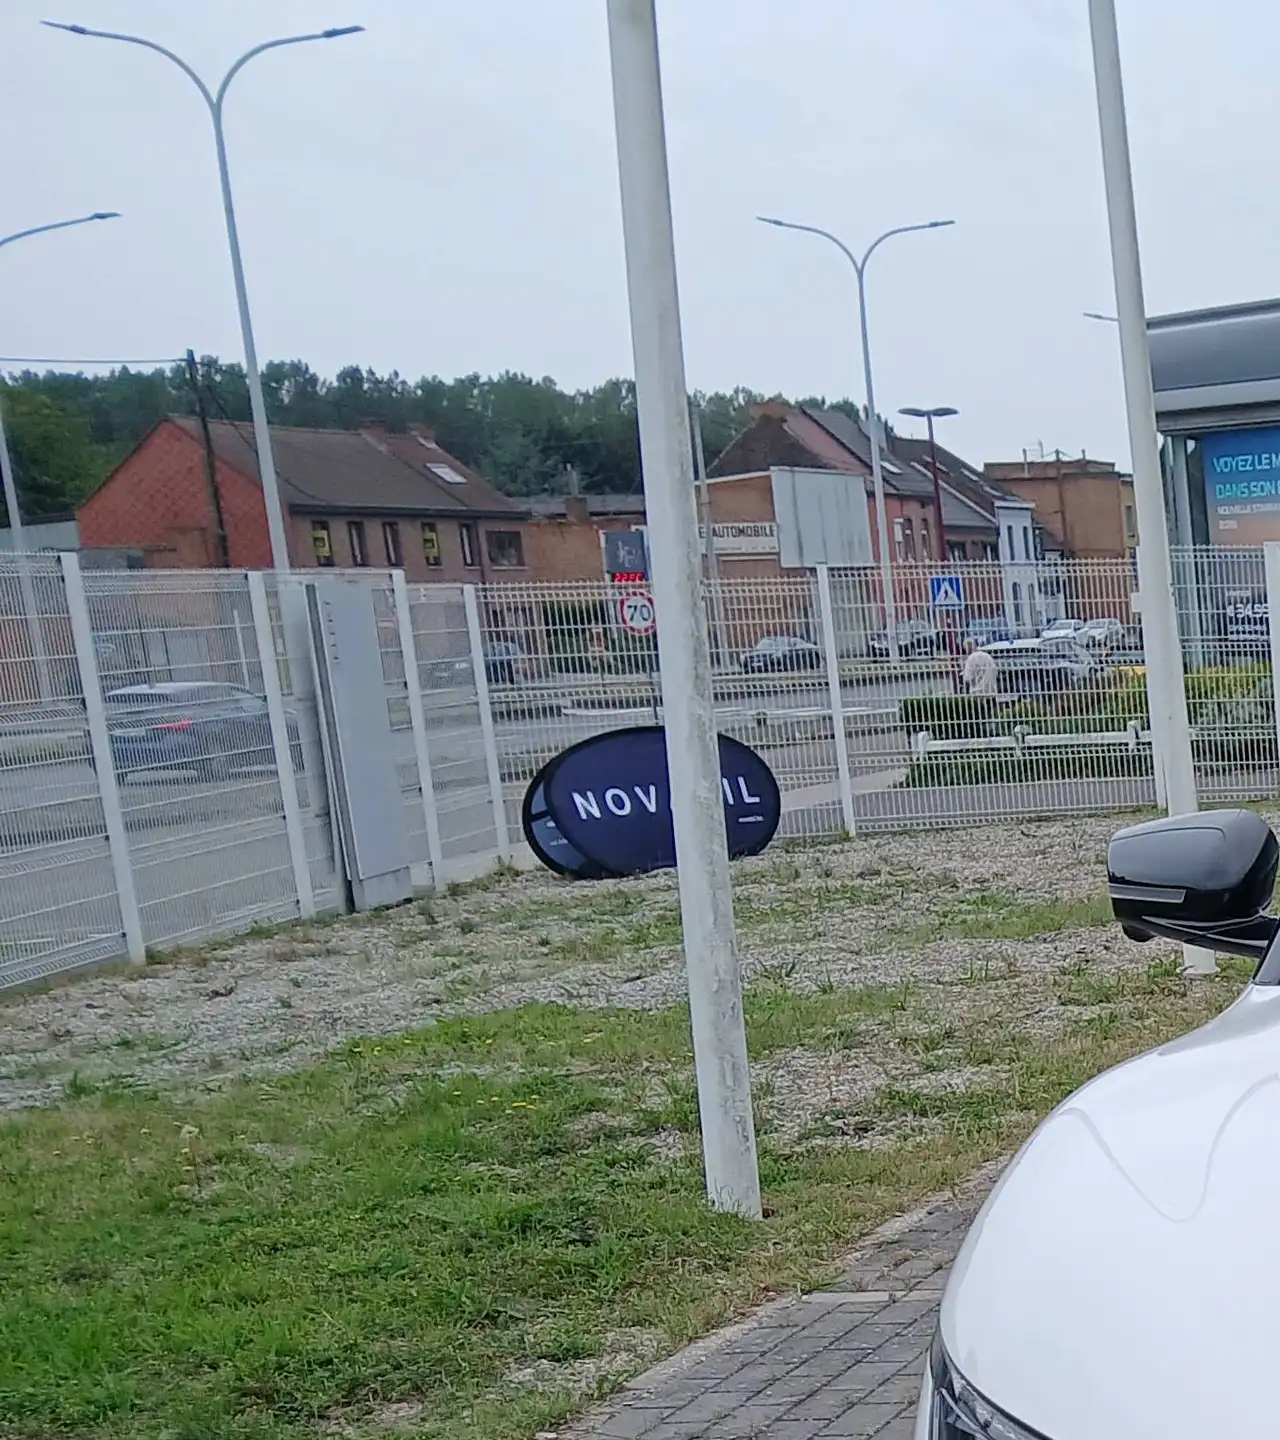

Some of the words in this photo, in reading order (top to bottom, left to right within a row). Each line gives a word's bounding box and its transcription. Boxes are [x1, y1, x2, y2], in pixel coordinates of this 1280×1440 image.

[1213, 456, 1253, 473] VOYEZ
[1254, 453, 1270, 470] LE
[1216, 481, 1249, 500] DANS
[1250, 480, 1275, 498] SON
[712, 525, 776, 539] AUTOMOBILE
[627, 604, 651, 622] 70
